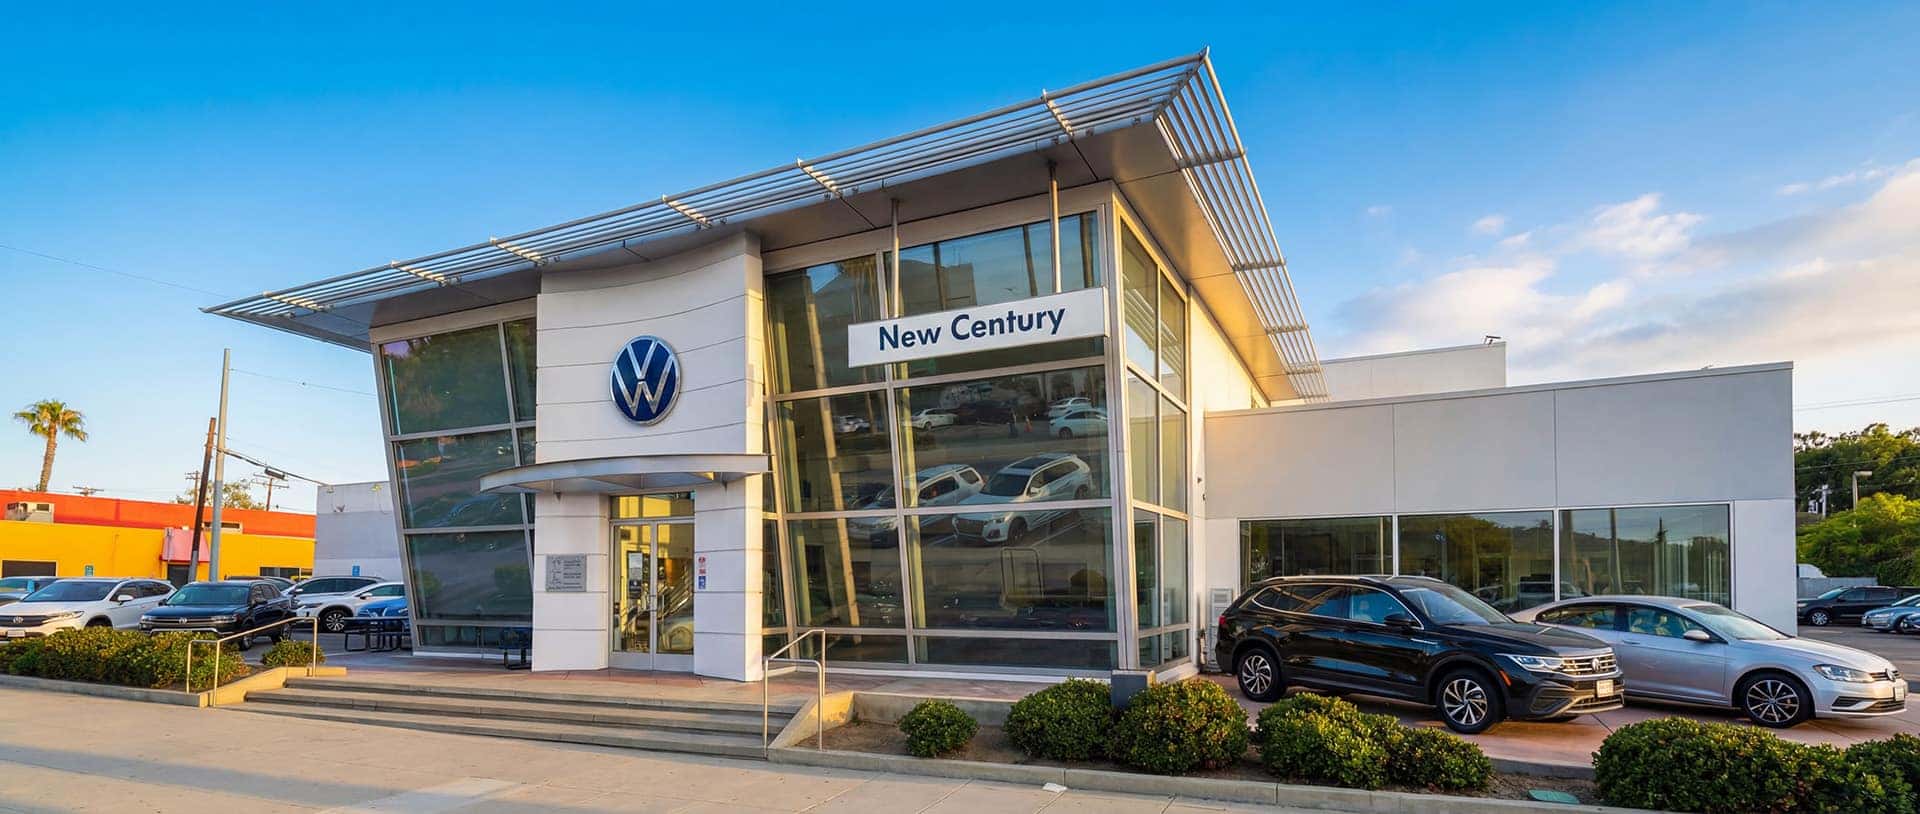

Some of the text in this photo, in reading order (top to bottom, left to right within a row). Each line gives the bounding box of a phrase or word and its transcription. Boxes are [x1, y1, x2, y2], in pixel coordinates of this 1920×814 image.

[879, 308, 1066, 351] New Century
[612, 337, 675, 417] VW
